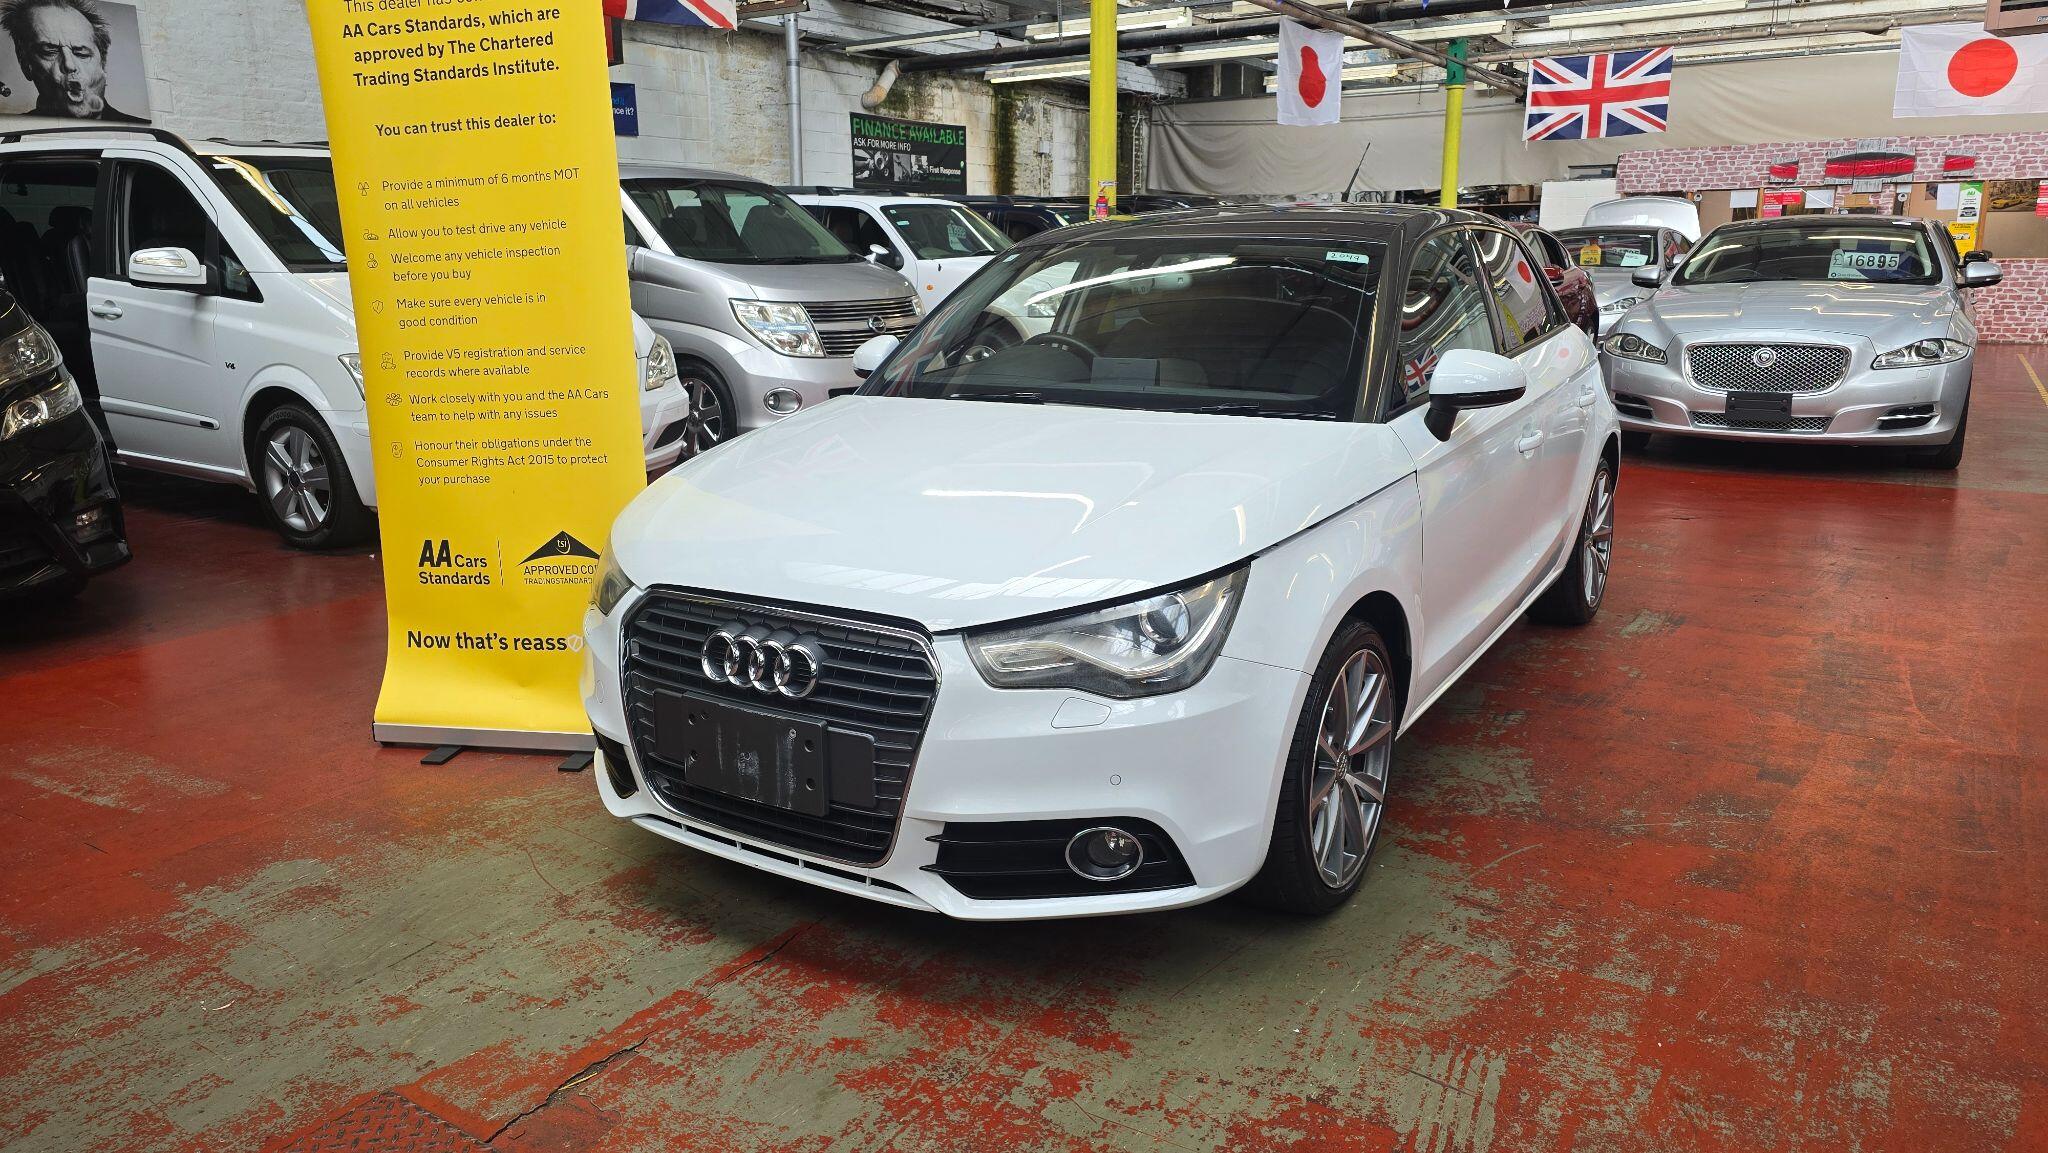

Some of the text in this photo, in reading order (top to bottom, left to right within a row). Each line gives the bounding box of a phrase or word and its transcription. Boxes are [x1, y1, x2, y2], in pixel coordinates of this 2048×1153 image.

[344, 0, 374, 13] This
[379, 0, 422, 10] dealer
[342, 7, 560, 38] AA Cars Standards, which are
[354, 31, 554, 65] approved by The Chartered
[353, 58, 560, 87] Trading Standards Institute.
[375, 112, 557, 137] You can trust this dealer to:
[853, 118, 965, 146] FINANCE AVAILABLE
[854, 138, 912, 152] ASK FOR MORE INFO
[382, 168, 580, 192] Provide a minimum of 6 months MOT
[384, 197, 460, 211] on all vehicles
[388, 219, 567, 240] Allow you to test drive any vehicle
[391, 246, 560, 264] Welcome any vehicle inspection
[393, 268, 472, 283] before you buy
[396, 292, 546, 309] Make sure every vehicle is in
[399, 315, 478, 330] good condition
[404, 344, 586, 361] Provide V5 registration and service
[406, 364, 530, 378] records where available
[408, 388, 609, 405] Work closely with you and the AA Cars
[411, 408, 558, 422] team to help with any issues
[414, 436, 592, 451] Honour their obligations under the
[416, 454, 608, 468] Consumer Rights Act 2015 to protect
[419, 474, 491, 486] your purchase
[418, 539, 488, 568] AA Cars
[419, 571, 490, 585] Standards
[524, 564, 598, 575] APPROVED CO
[407, 630, 451, 649] Now
[456, 632, 508, 651] that's
